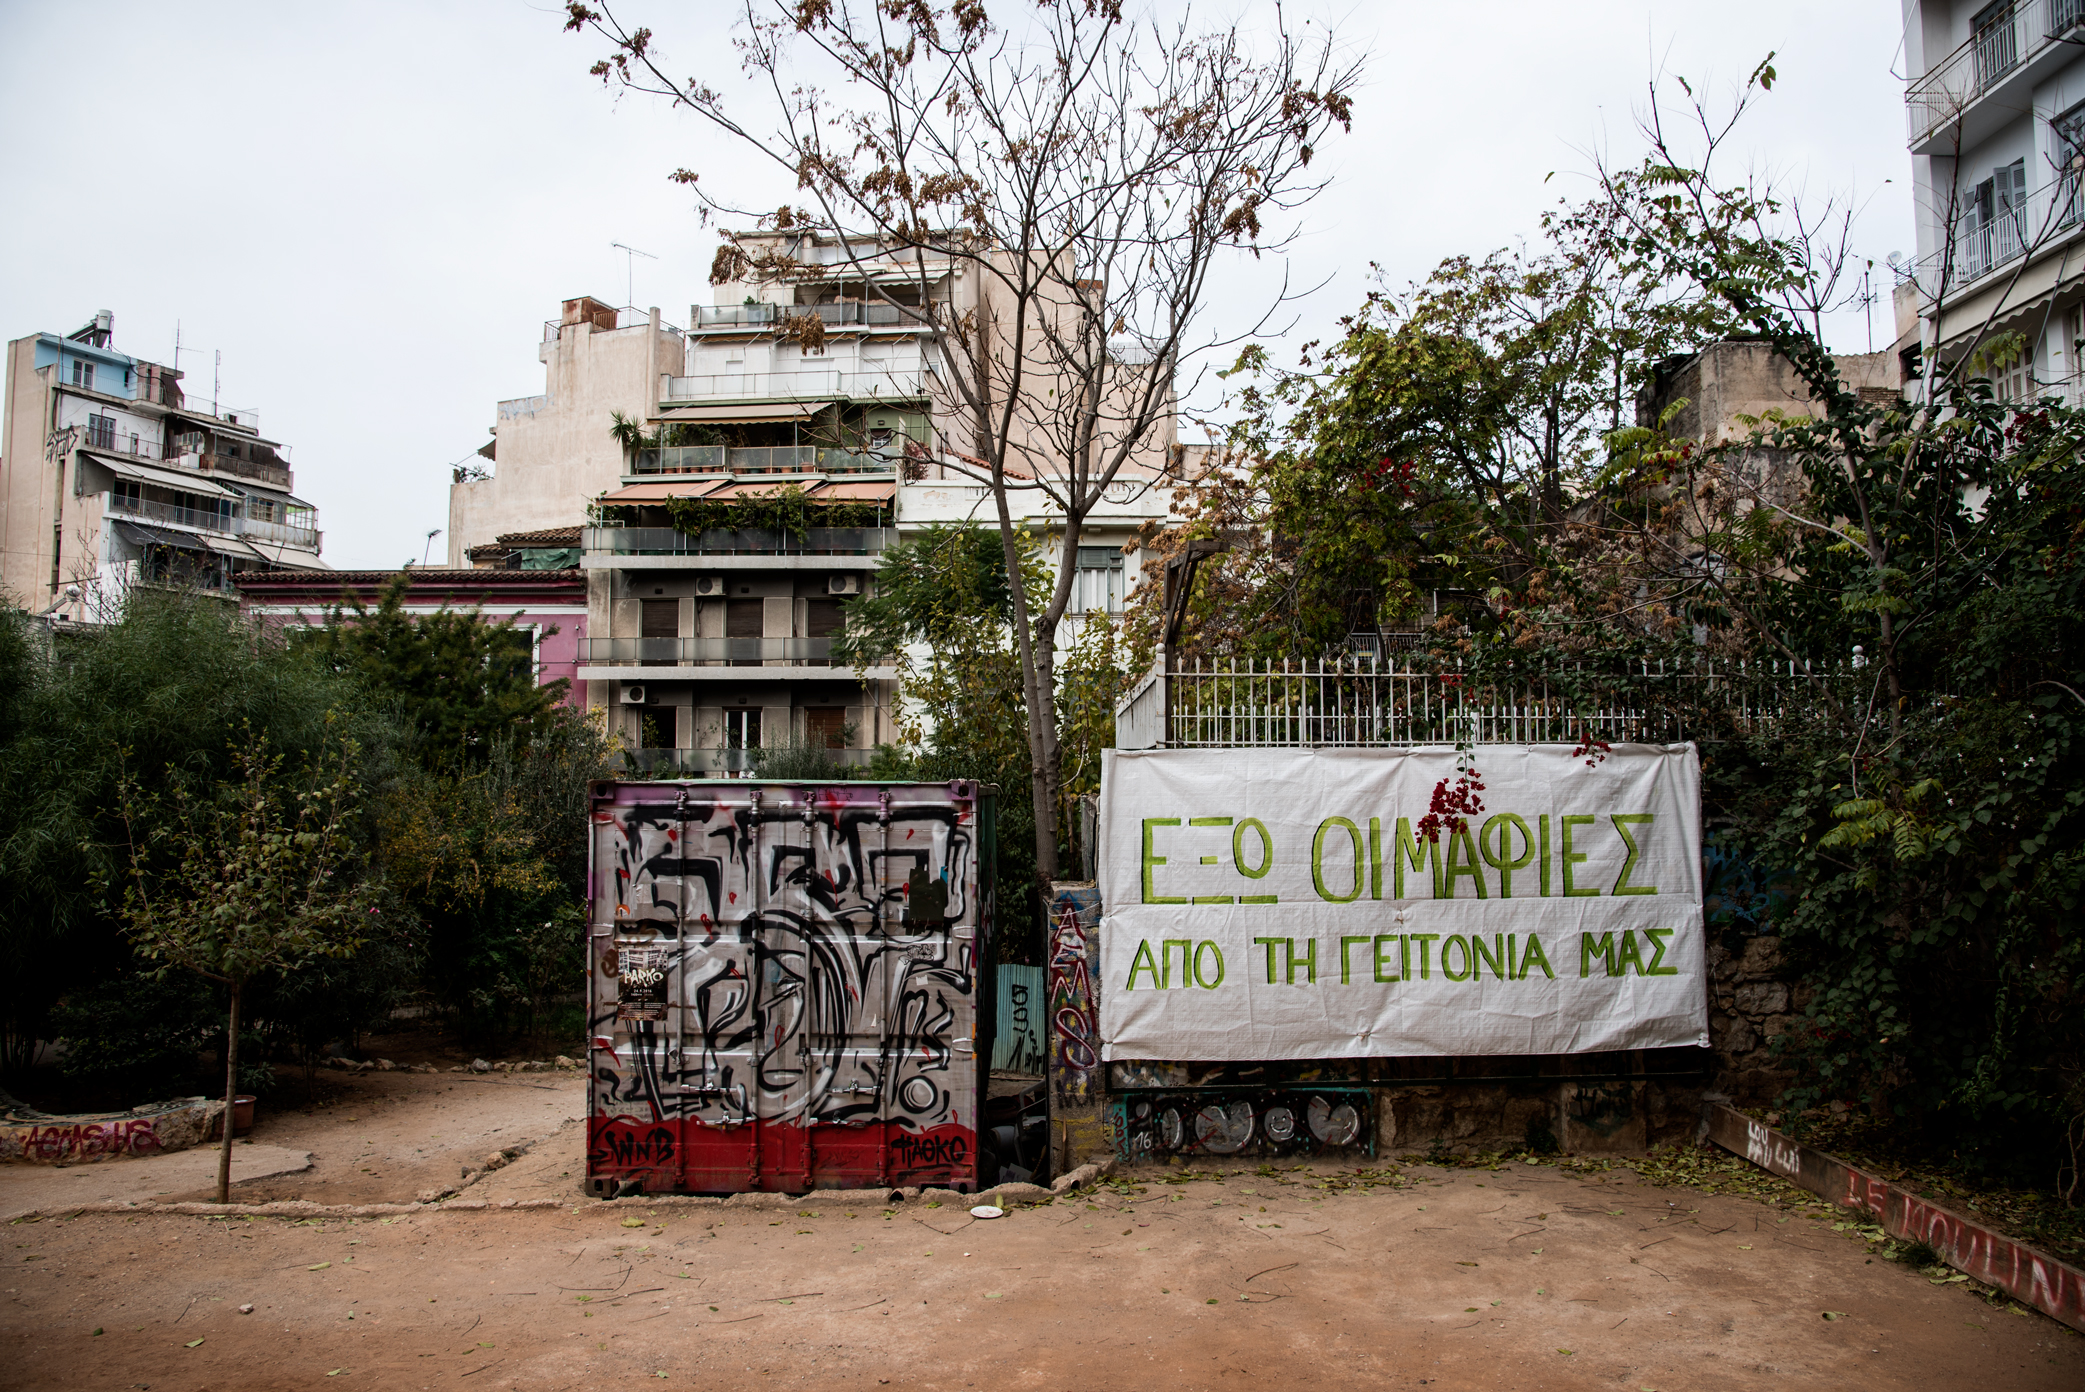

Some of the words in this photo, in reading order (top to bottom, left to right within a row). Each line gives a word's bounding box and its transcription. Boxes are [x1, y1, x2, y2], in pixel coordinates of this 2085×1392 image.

[1126, 938, 1225, 991] ΑΠΟ
[1254, 936, 1316, 986] ΤΗ
[1340, 932, 1555, 985] ΓΕΙΤΟΝΙΑ
[1580, 927, 1678, 979] ΜΑΣ
[624, 968, 664, 987] PARKO
[1134, 1131, 1152, 1150] 16
